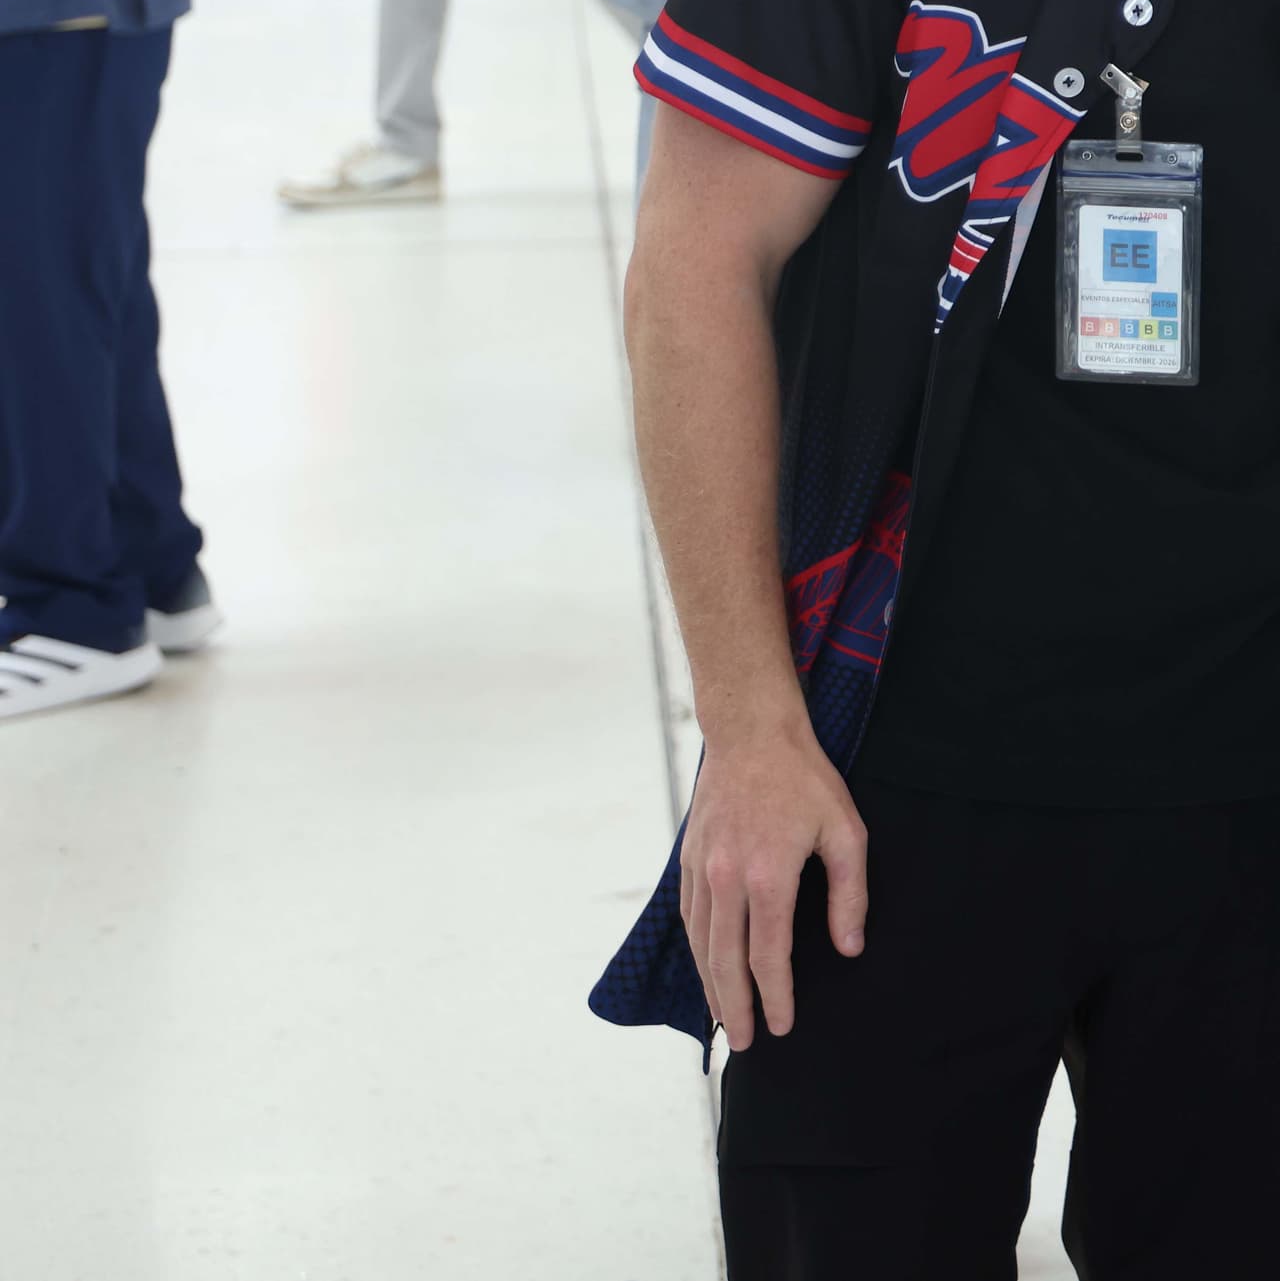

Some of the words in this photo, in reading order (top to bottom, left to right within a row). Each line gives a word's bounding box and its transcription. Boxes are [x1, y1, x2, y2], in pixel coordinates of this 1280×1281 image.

[1110, 243, 1150, 269] EE
[1085, 321, 1094, 332] B
[1104, 322, 1114, 333] B
[1124, 323, 1134, 334] B
[1144, 324, 1153, 335] B
[1163, 325, 1173, 336] B
[1095, 341, 1166, 353] INTRANSFERIBLE
